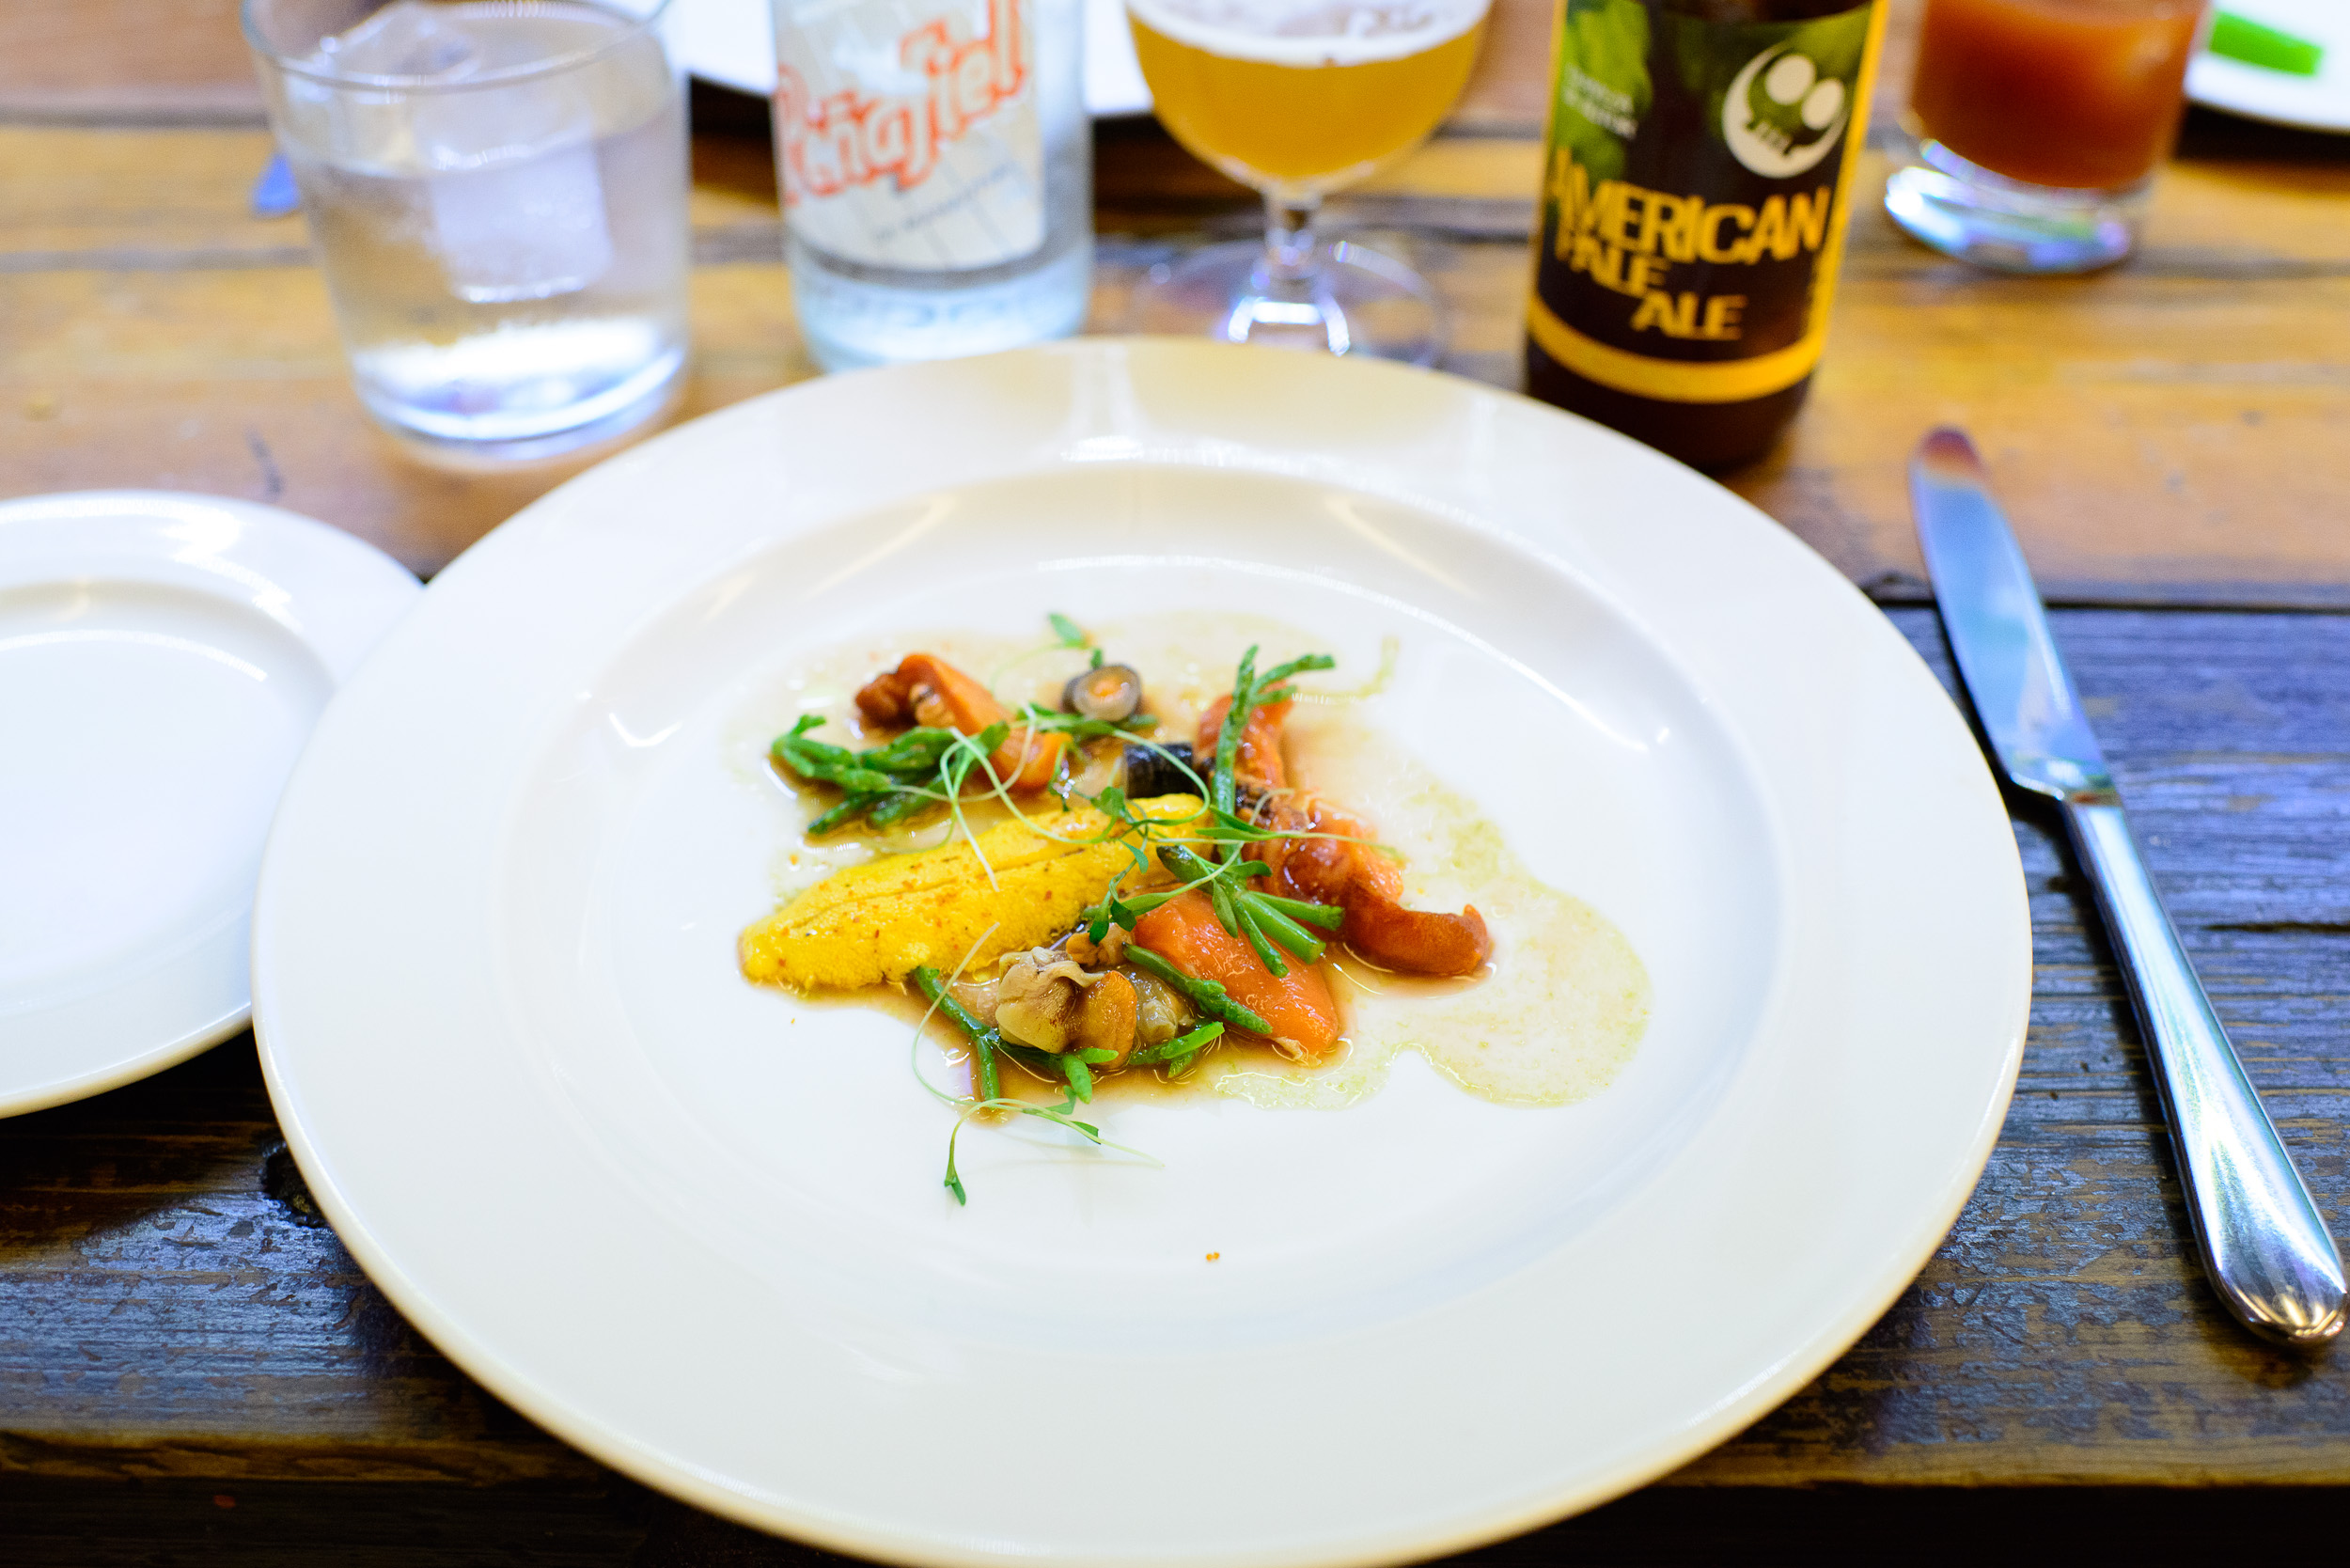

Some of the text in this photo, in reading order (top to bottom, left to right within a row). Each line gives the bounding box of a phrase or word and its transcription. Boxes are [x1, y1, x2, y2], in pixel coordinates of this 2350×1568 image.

[1551, 146, 1830, 264] AMERICAN
[1570, 234, 1670, 298] PALE
[1631, 291, 1747, 340] ALE
